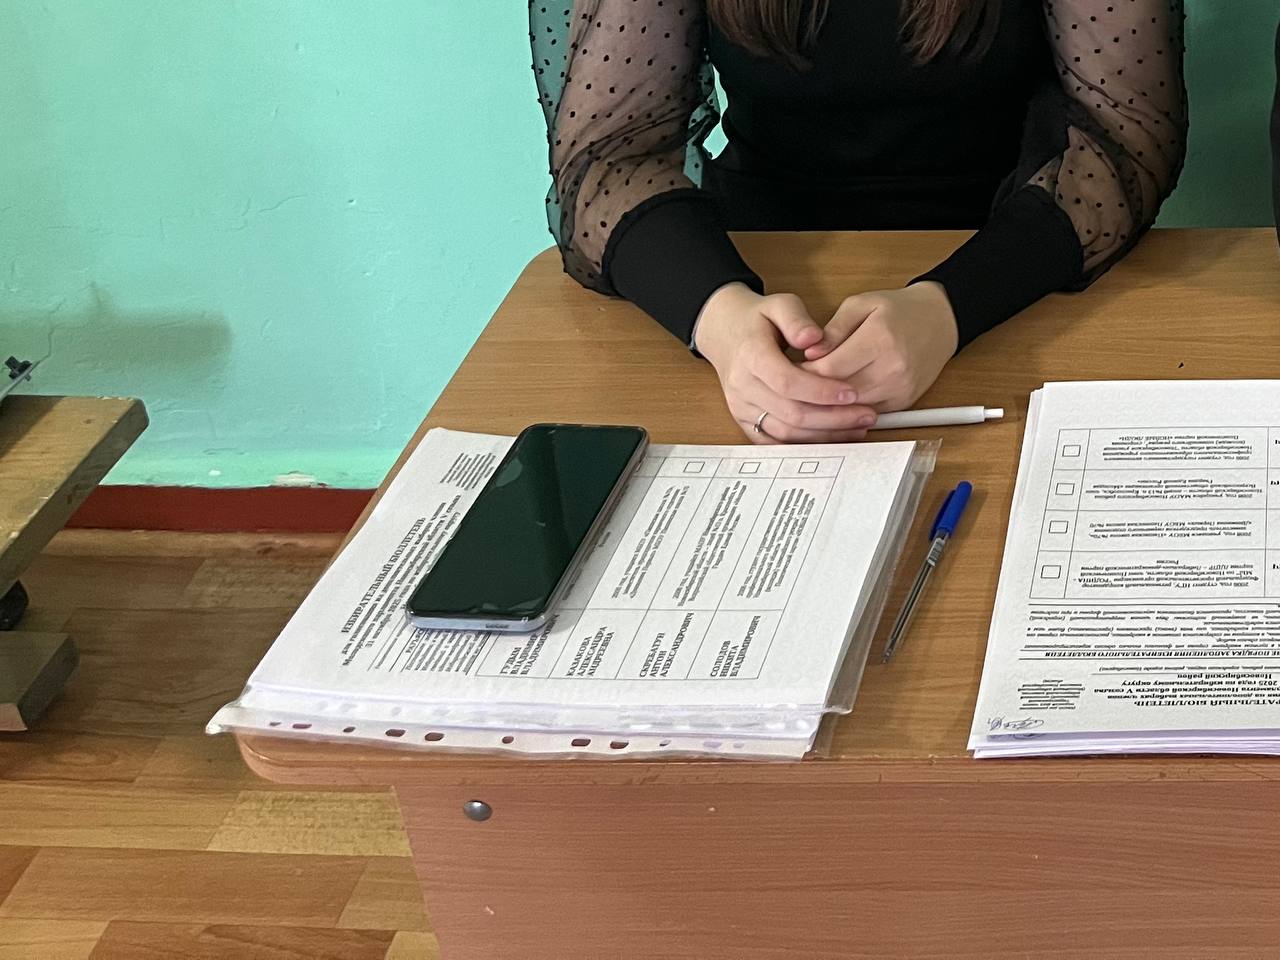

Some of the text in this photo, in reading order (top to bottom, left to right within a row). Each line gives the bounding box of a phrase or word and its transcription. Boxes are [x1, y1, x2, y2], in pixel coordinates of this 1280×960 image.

[340, 517, 426, 633] ИЗБИРАТЕЛЬНЫЙ БЮЛЛЕТЕНЬ
[499, 646, 522, 674] ГУДЫМ
[510, 633, 538, 674] ВЛАДИМИР
[565, 636, 592, 677] КАЗАКОВА
[576, 626, 608, 677] АЛЕКСАНДРА
[587, 631, 615, 677] АНДРЕЕВНА
[639, 632, 665, 677] СКРЕБАТУН
[649, 650, 667, 677] АНТОН
[659, 612, 694, 677] АЛЕКСАНДРОВИЧ
[710, 640, 731, 677] СОЛОДОВ
[719, 645, 740, 677] НИКИТА
[730, 615, 761, 677] ВЛАДИМИРОВИЧ
